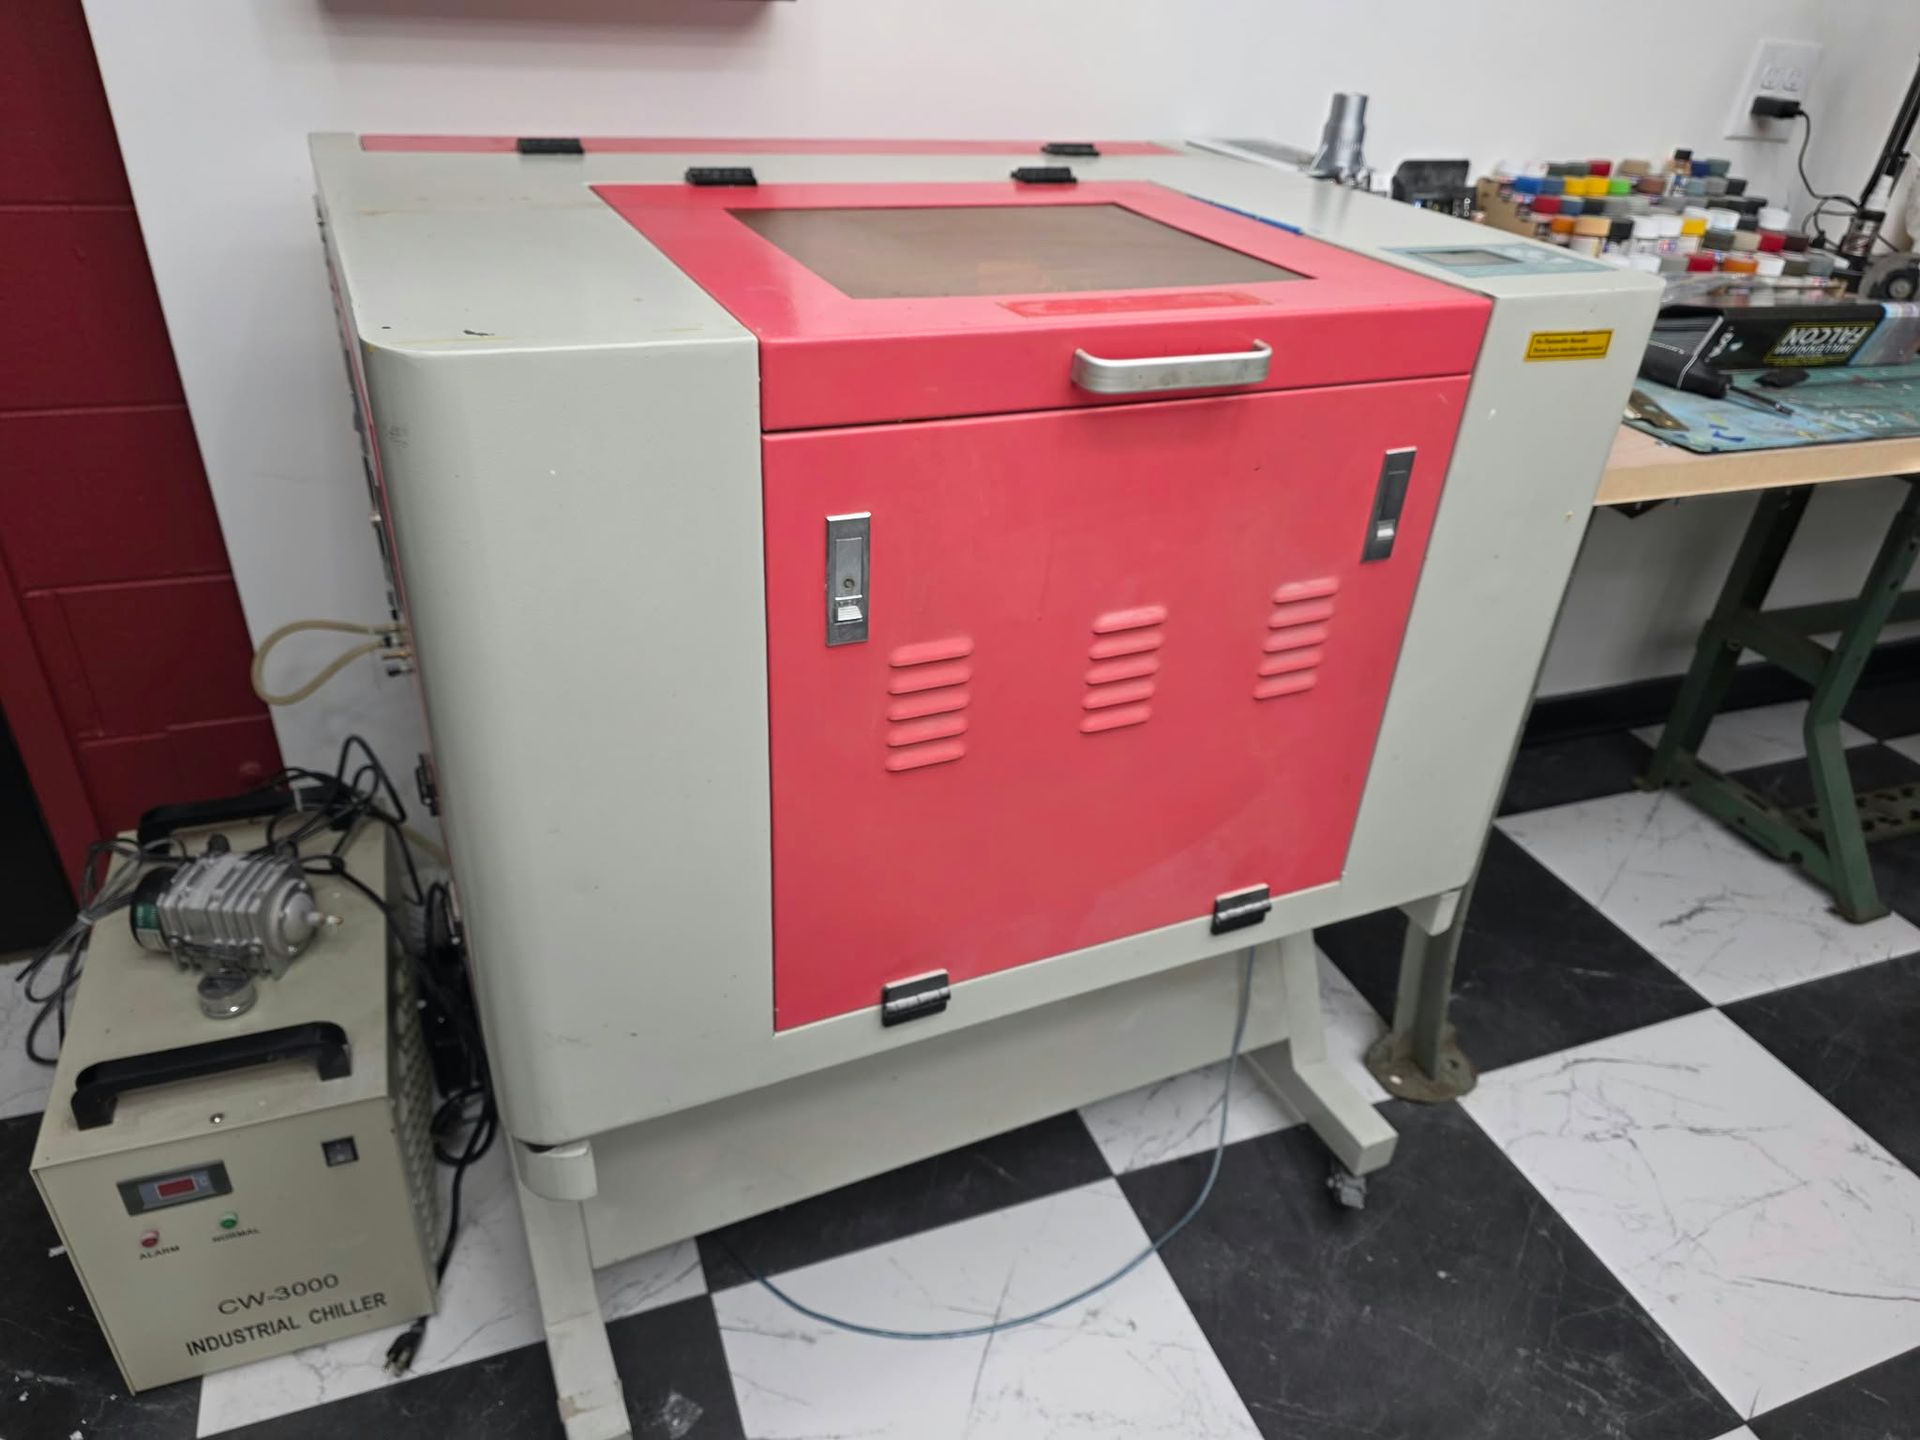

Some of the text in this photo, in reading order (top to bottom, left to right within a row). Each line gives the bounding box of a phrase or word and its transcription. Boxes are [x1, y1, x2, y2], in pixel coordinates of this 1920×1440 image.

[1781, 326, 1869, 345] FALCON
[1773, 343, 1855, 355] MILLENNIUM
[212, 1227, 260, 1243] NORMAL
[139, 1245, 181, 1260] ALARM
[217, 1273, 340, 1315] CW-3000
[185, 1292, 388, 1356] INDUSTRIAL CHILLER
